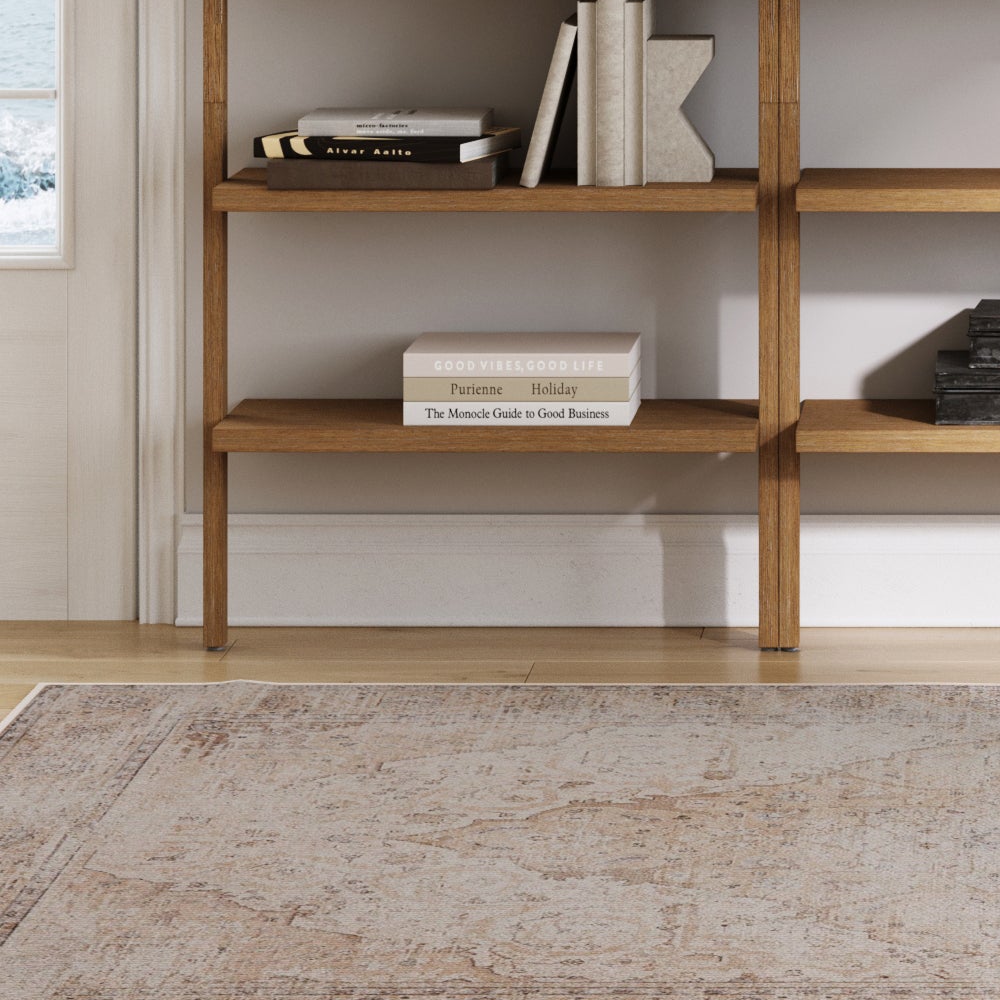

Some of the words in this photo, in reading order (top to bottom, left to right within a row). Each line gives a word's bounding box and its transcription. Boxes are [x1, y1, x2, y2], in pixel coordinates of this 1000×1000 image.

[326, 147, 365, 155] Alvar
[373, 148, 412, 156] Aalto
[434, 360, 475, 371] GOOD
[527, 360, 568, 371] GOOD
[573, 360, 604, 371] LIFE
[450, 382, 503, 396] Purienne
[531, 382, 578, 398] Holiday
[425, 407, 445, 419] The
[448, 407, 490, 419] Monocle
[492, 407, 523, 419] Guide
[525, 408, 535, 419] to
[537, 407, 565, 419] Good
[568, 407, 610, 419] Business
